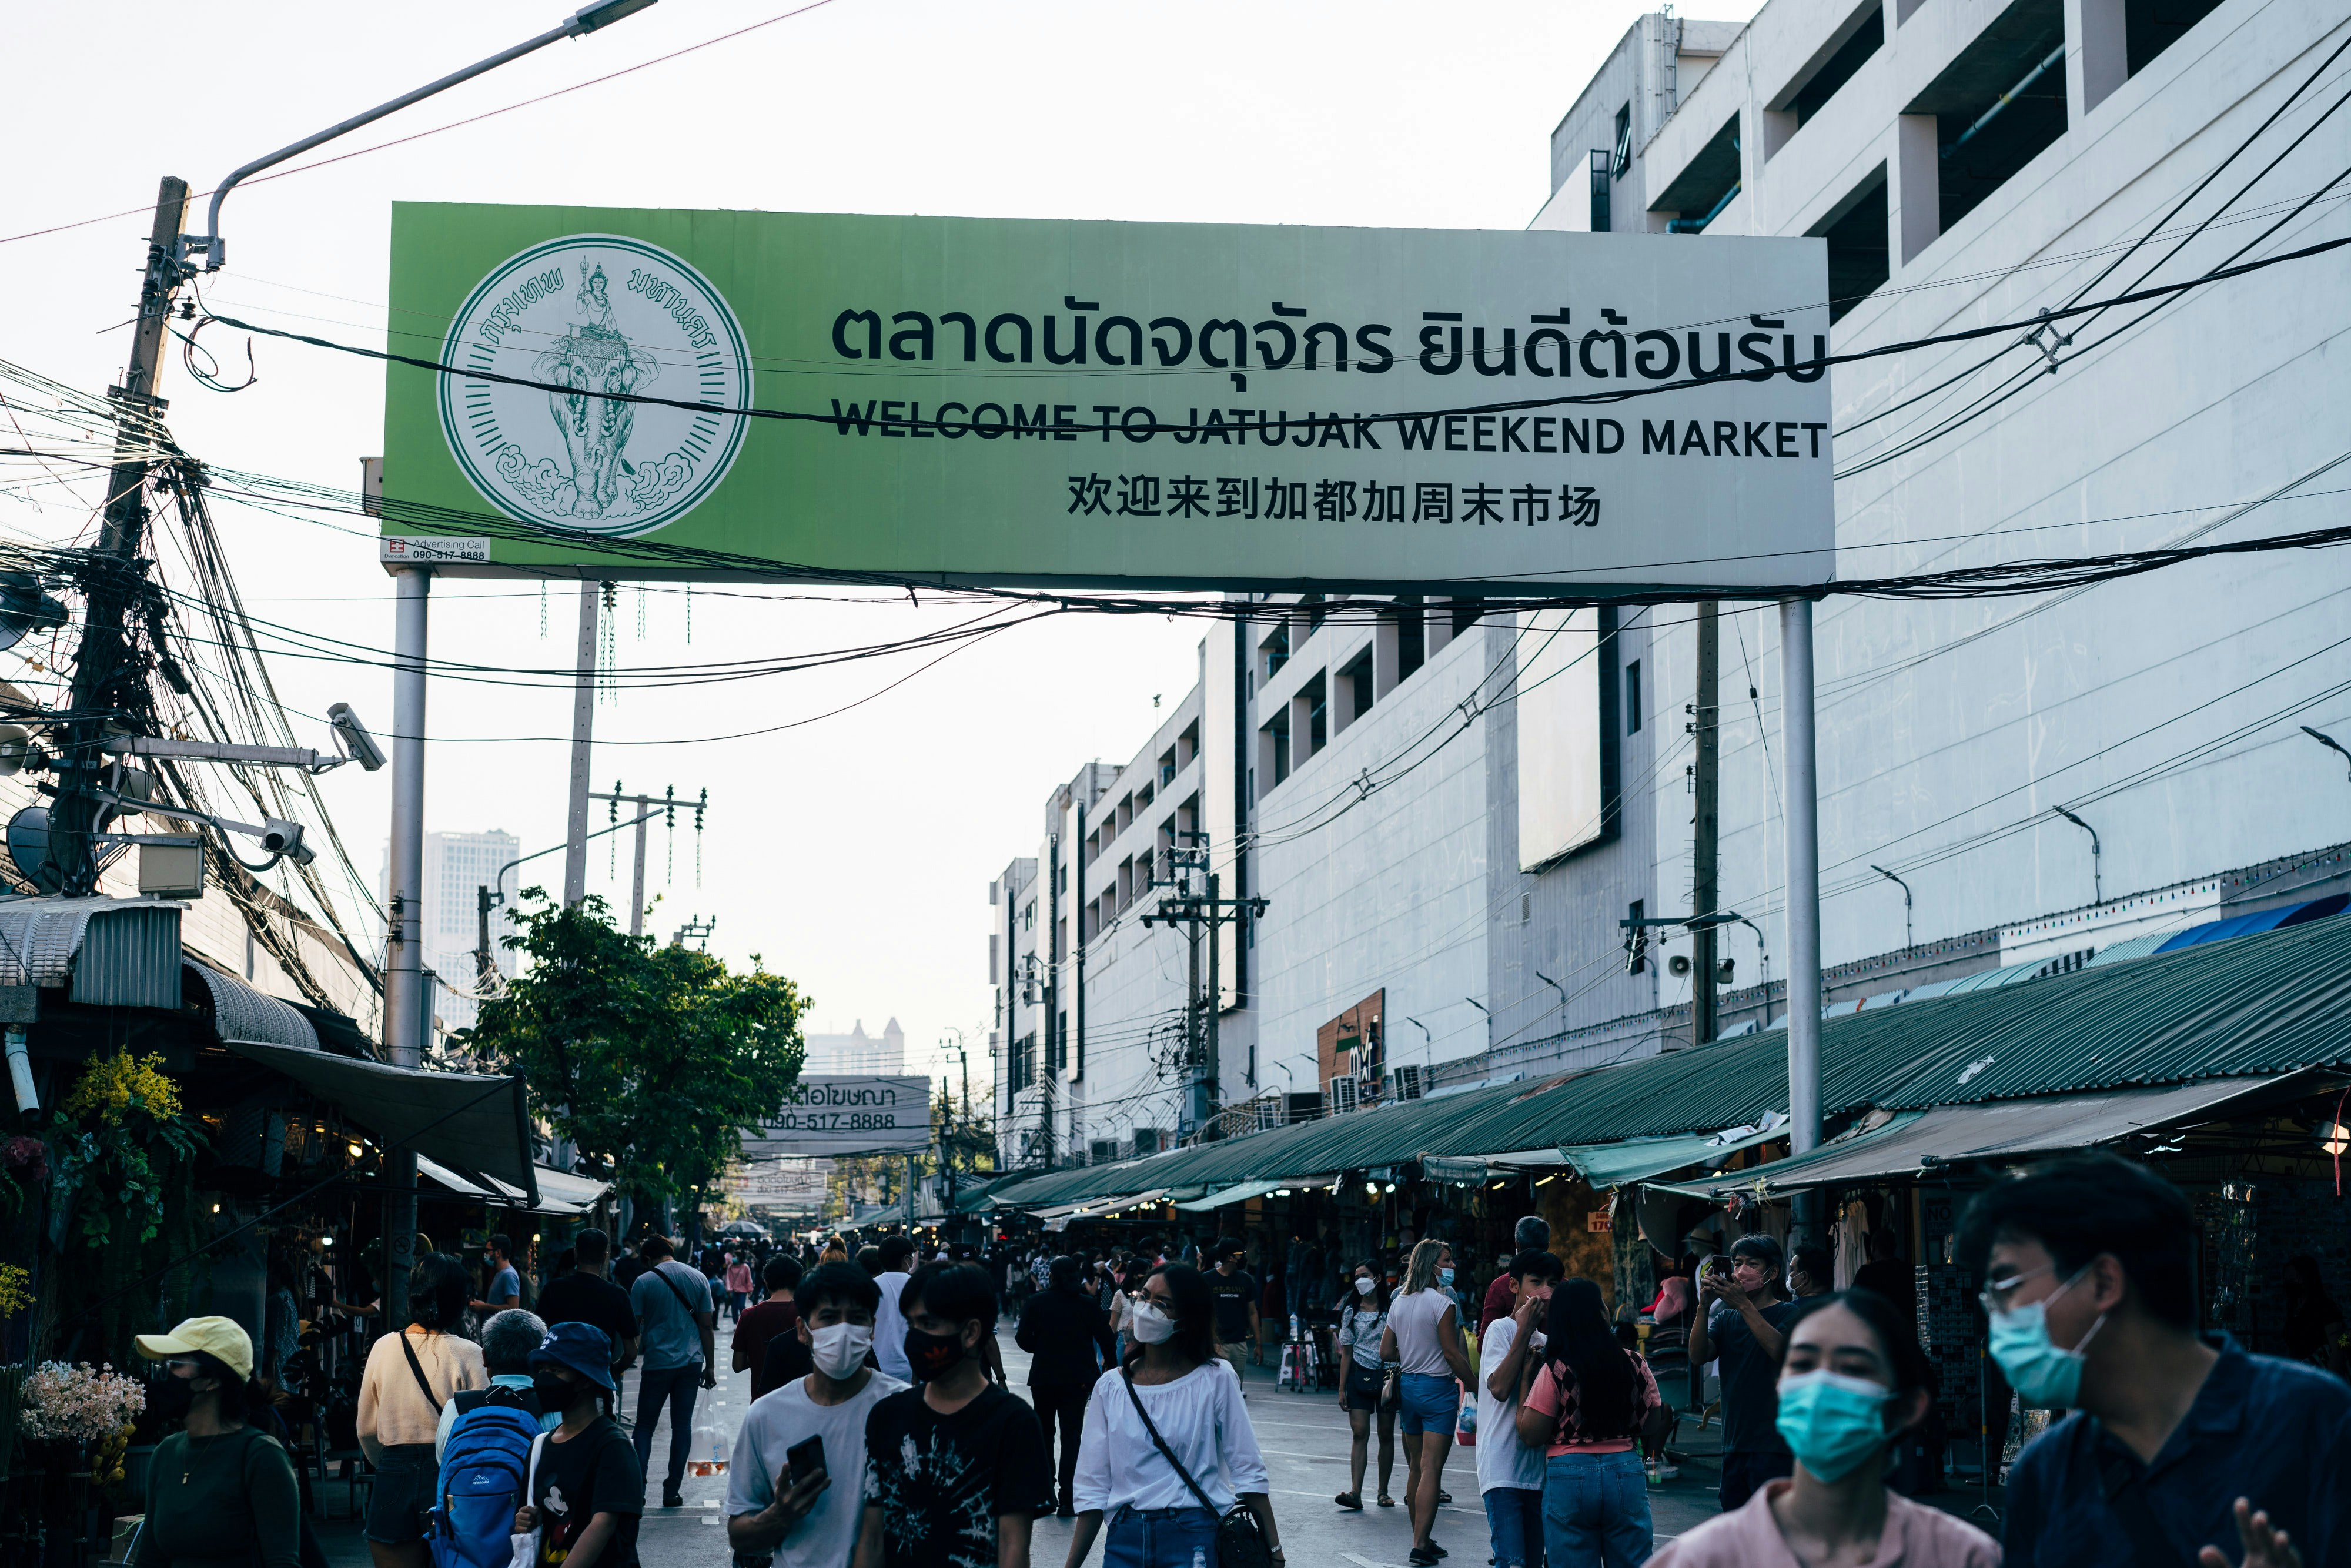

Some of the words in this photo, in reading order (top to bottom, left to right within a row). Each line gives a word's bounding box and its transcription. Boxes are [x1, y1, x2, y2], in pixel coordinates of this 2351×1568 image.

[480, 267, 564, 344] กรุงเทพ
[627, 269, 717, 349] มหานคร
[832, 296, 1394, 392] ตลาดนัดจตุจักร
[1419, 307, 1825, 383] ยินดีต้อนรับ
[831, 399, 1077, 441] WELCOME
[1093, 406, 1156, 443] TO
[1173, 408, 1382, 449] JATUJAK
[1397, 414, 1625, 454] WEEKEND
[1643, 419, 1827, 459] MARKET
[1067, 472, 1601, 527] 欢迎来到加都加周末市场
[413, 539, 464, 550] Advertising
[467, 540, 484, 549] Call
[413, 550, 484, 560] 090-517-8888
[763, 1113, 895, 1130] 090-517-8888
[1928, 1206, 1951, 1221] NO
